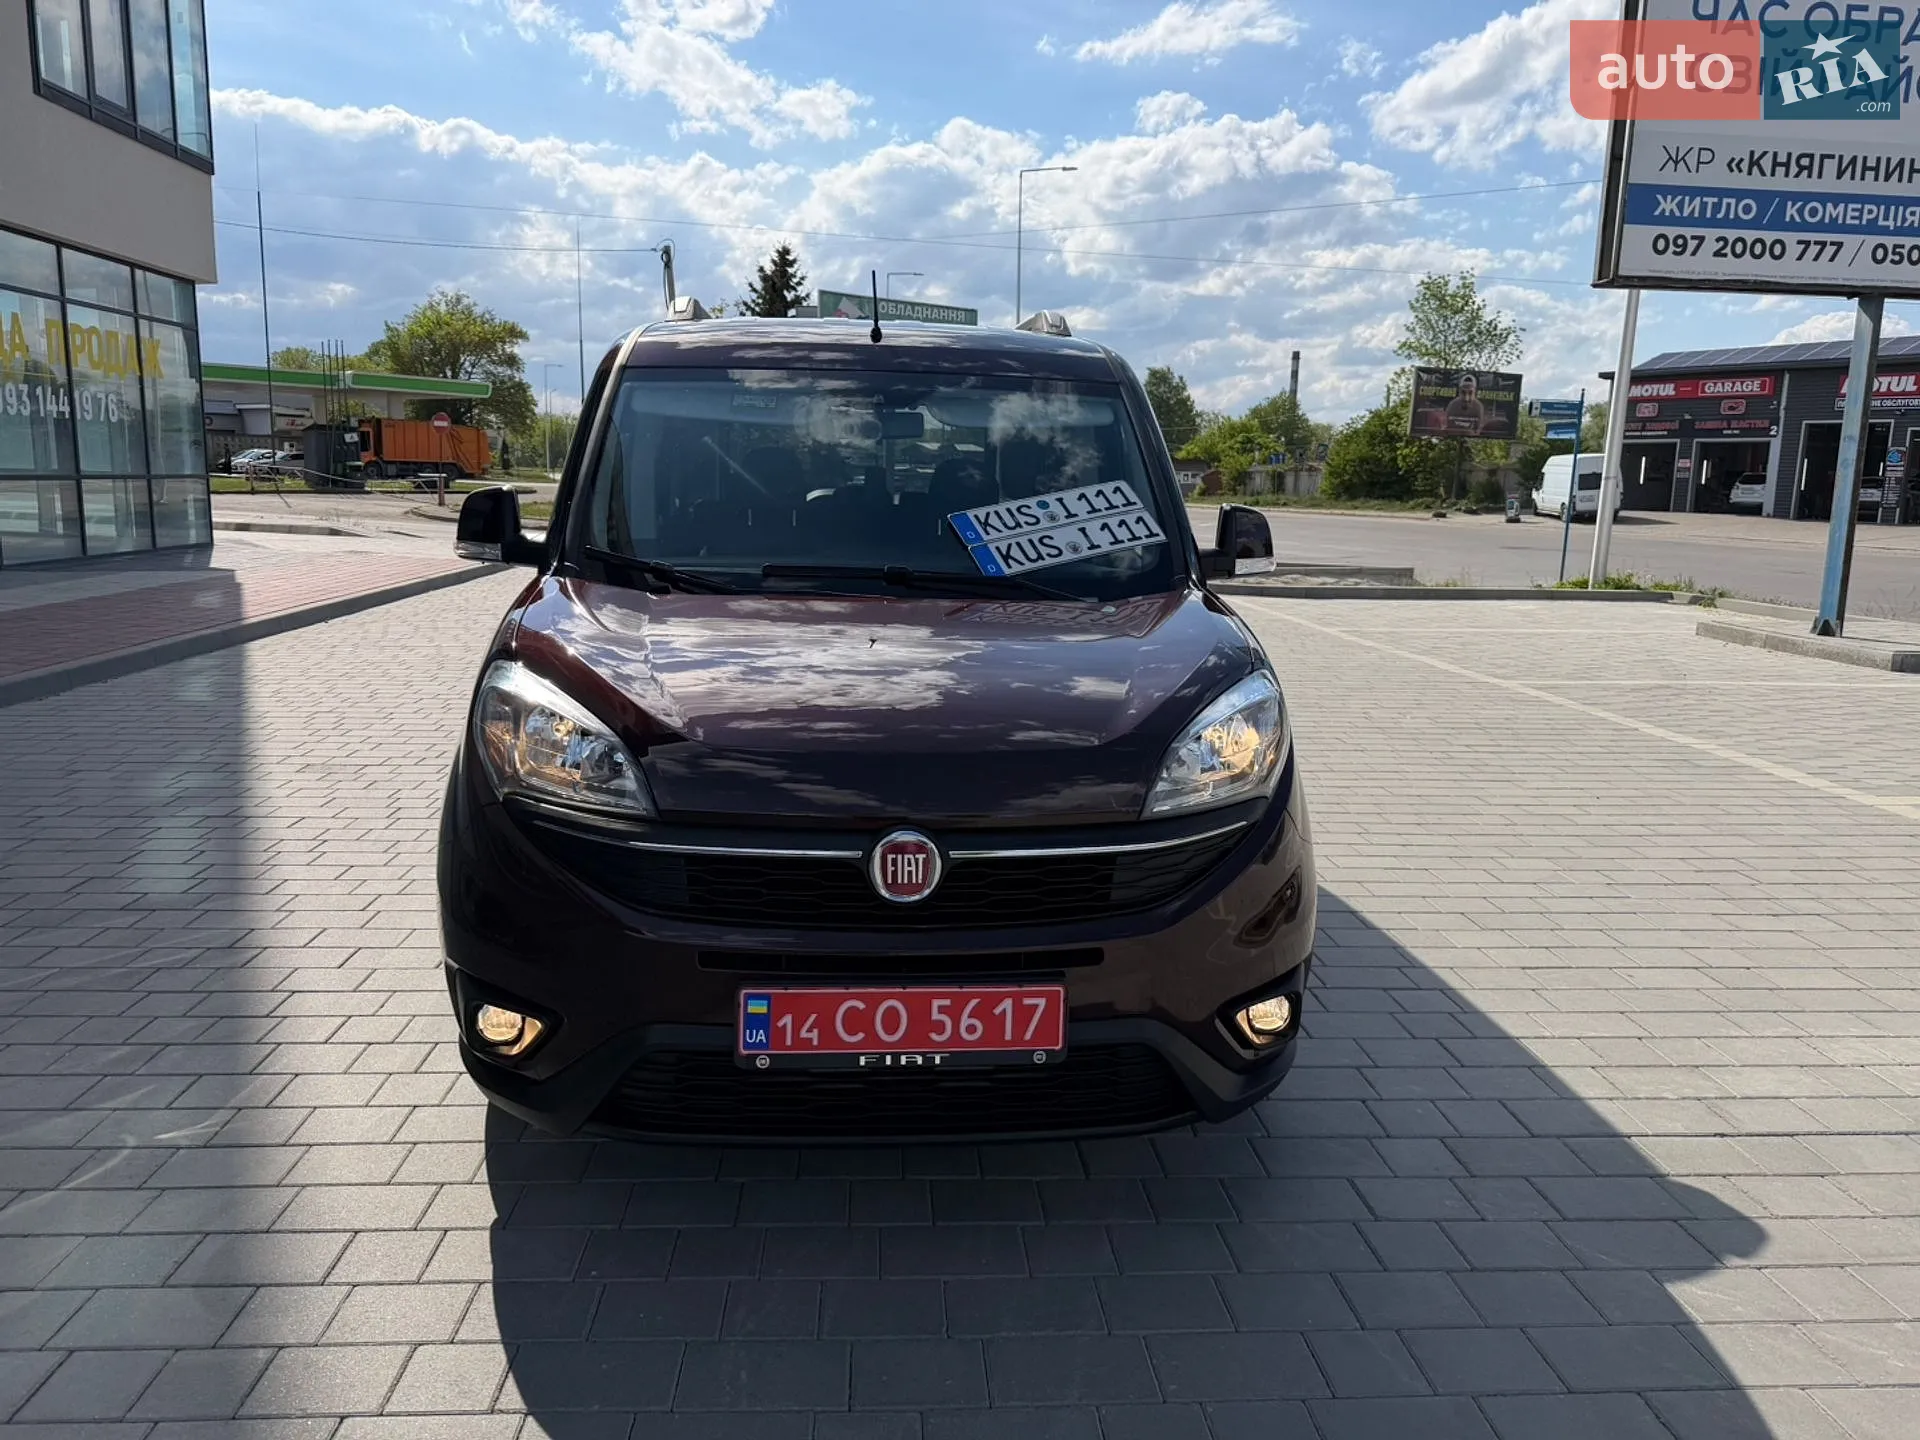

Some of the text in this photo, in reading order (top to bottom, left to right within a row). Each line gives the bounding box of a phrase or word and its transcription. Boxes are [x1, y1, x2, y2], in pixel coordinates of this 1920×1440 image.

[1659, 145, 1716, 174] ЖР
[1654, 194, 1757, 220] ЖИТЛО
[1785, 201, 1920, 230] КОМЕРЦІЯ
[1652, 233, 1706, 256] 097
[1713, 236, 1787, 260] 2000
[1795, 240, 1844, 262] 777
[1871, 243, 1920, 266] 050
[879, 301, 966, 323] ОБЛАДНАННЯ
[45, 318, 164, 381] ПРОДАЖ
[36, 385, 70, 418] 144
[97, 392, 118, 422] 76
[1628, 381, 1761, 397] MOTUL GARAGE
[1769, 425, 1779, 435] 2
[973, 504, 1041, 536] KUS
[1078, 486, 1137, 515] 111
[995, 535, 1063, 569] KUS
[1100, 516, 1160, 546] 111
[887, 854, 927, 884] FIAT
[746, 998, 1047, 1046] UA 14 CO 5617
[859, 1054, 951, 1066] FIAT
